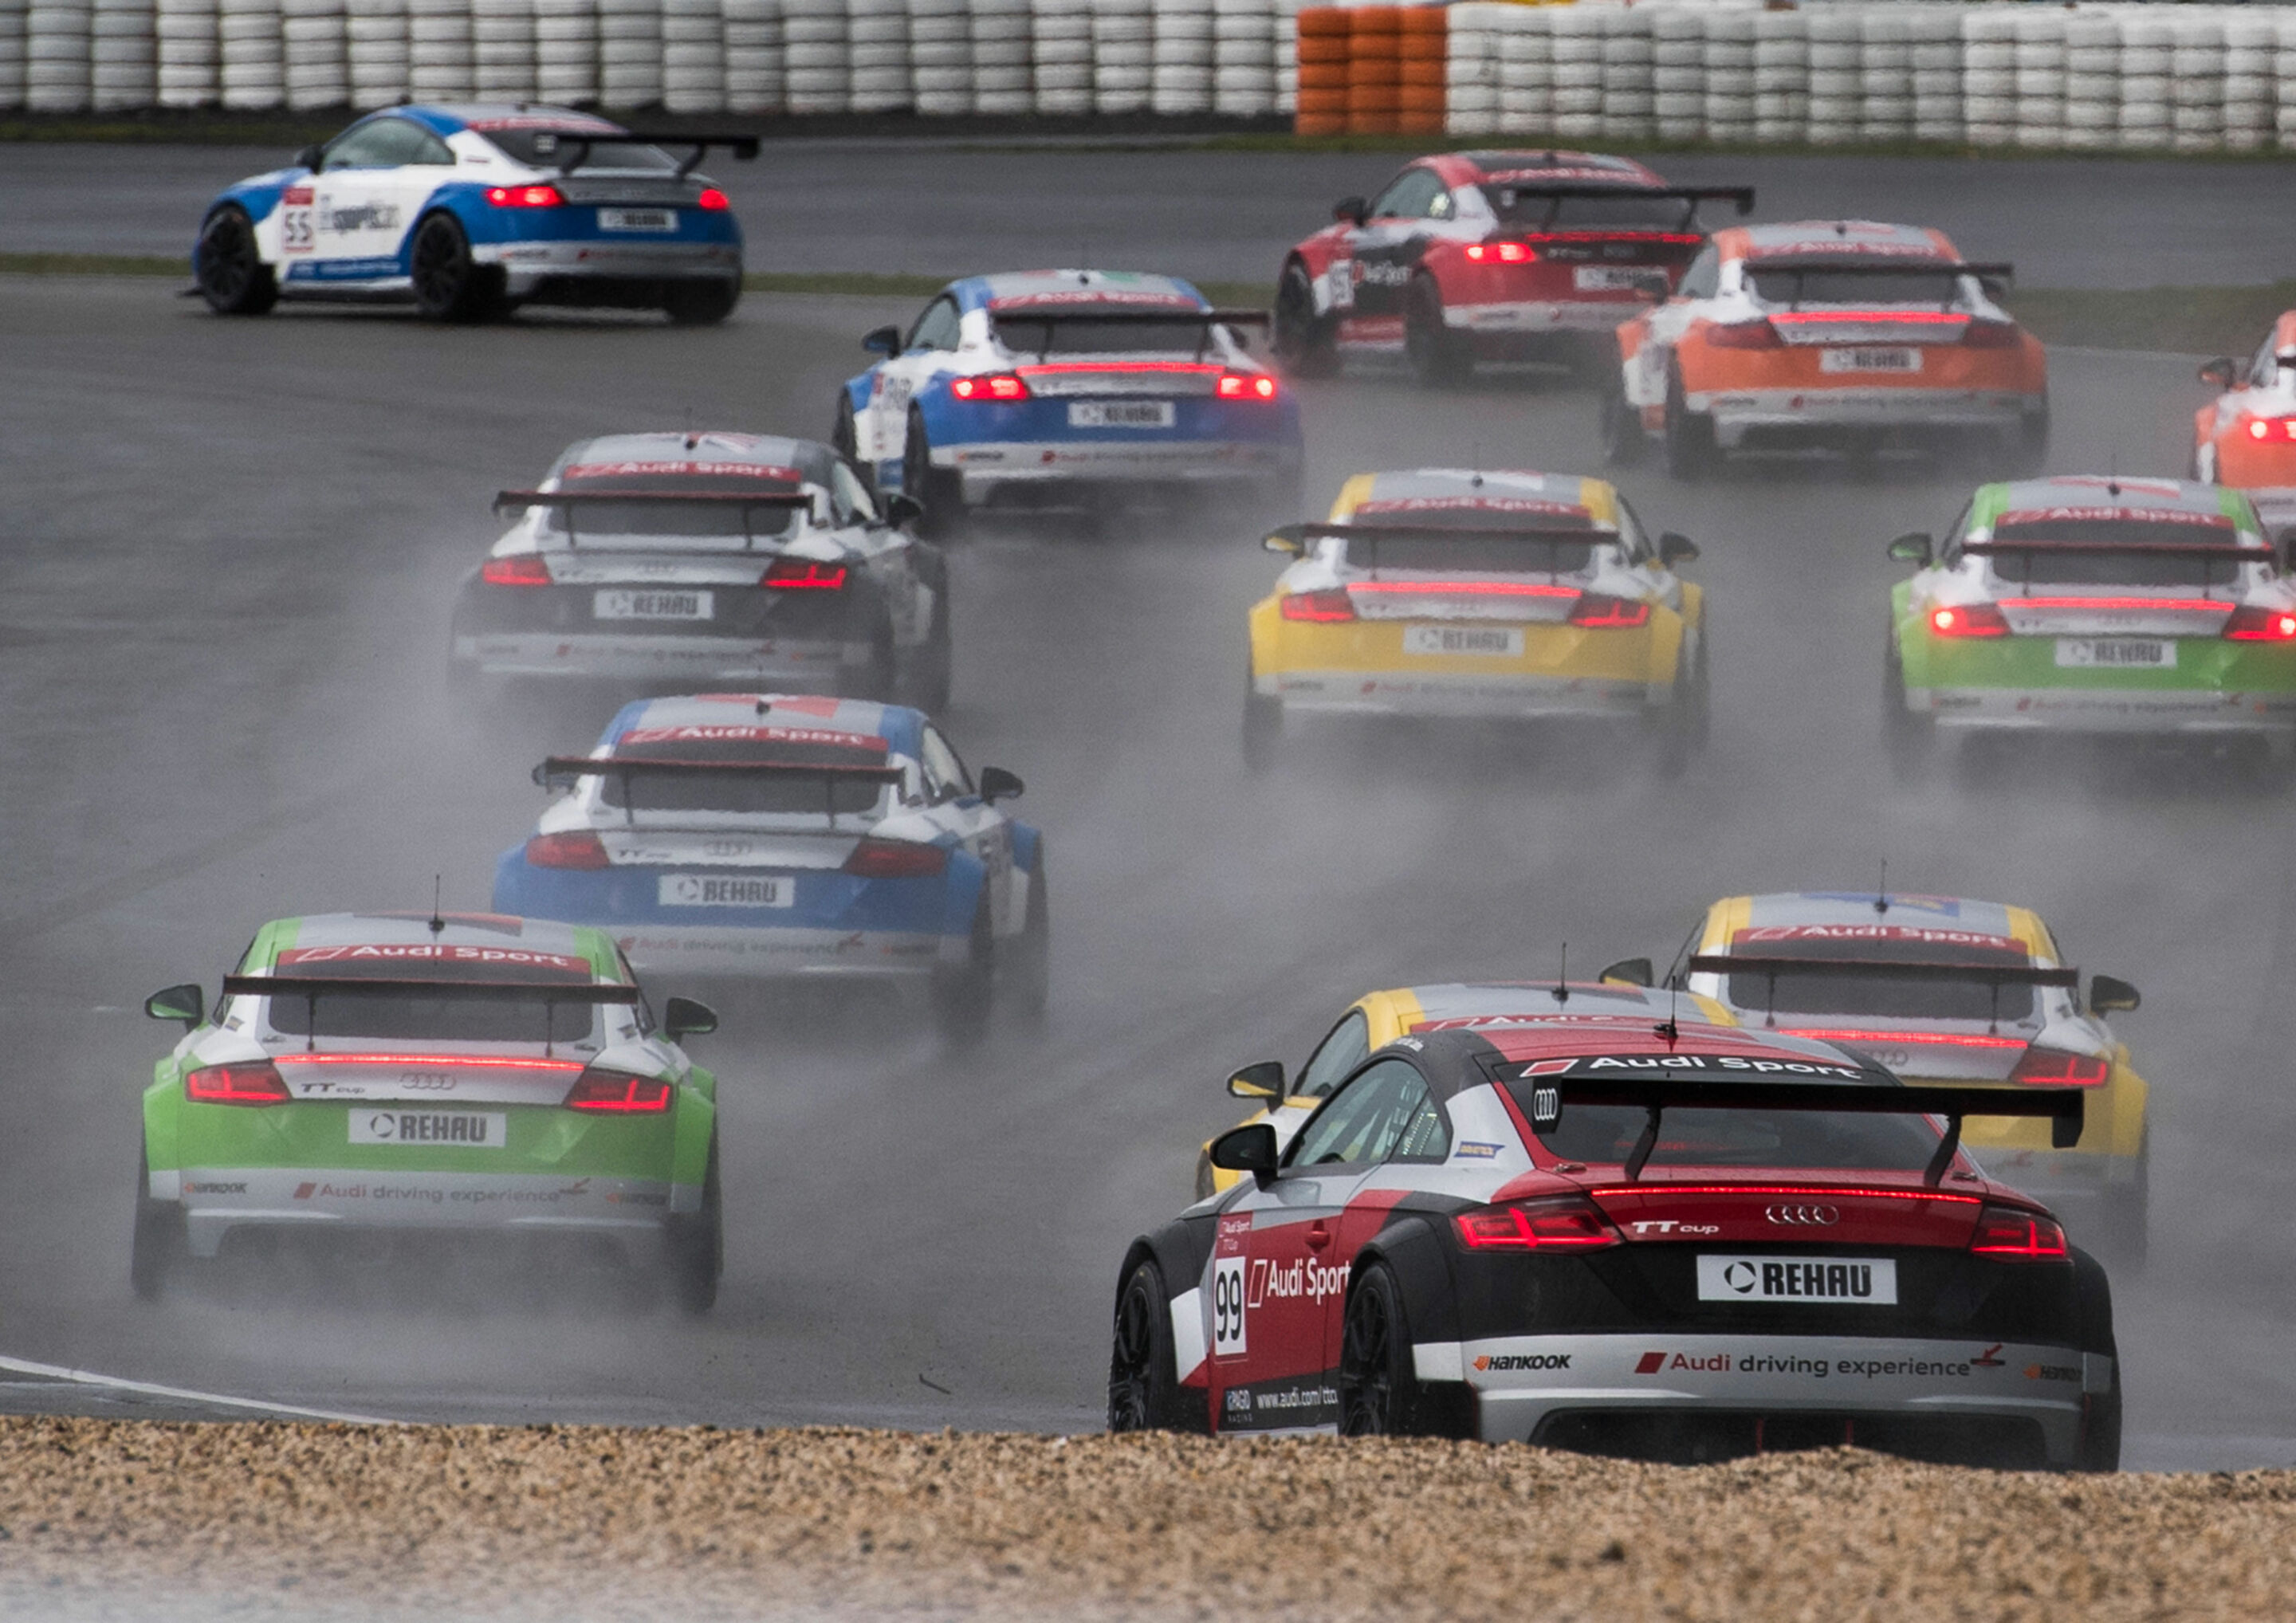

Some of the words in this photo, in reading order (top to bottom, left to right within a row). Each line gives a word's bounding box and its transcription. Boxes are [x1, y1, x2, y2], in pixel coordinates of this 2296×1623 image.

[285, 211, 313, 242] 55
[678, 725, 757, 739] Audi
[767, 727, 863, 745] Sport
[702, 879, 777, 903] REHAU
[1801, 925, 1887, 937] Audi
[1900, 926, 2007, 947] Sport
[350, 945, 443, 957] Audi
[454, 947, 569, 967] Sport
[1589, 1056, 1705, 1069] Audi
[1720, 1057, 1862, 1079] Sport
[301, 1082, 336, 1094] TT
[399, 1114, 488, 1142] REHAU
[320, 1183, 366, 1198] Audi
[372, 1185, 443, 1204] driving
[1631, 1220, 1680, 1234] TT
[1680, 1224, 1720, 1235] cup
[1267, 1258, 1303, 1298] Audi
[1306, 1256, 1351, 1307] Sport
[1762, 1262, 1873, 1298] REHAU
[1216, 1269, 1242, 1342] 99
[1670, 1353, 1731, 1372] Audi
[1739, 1354, 1829, 1378] driving
[1837, 1356, 1971, 1378] experience
